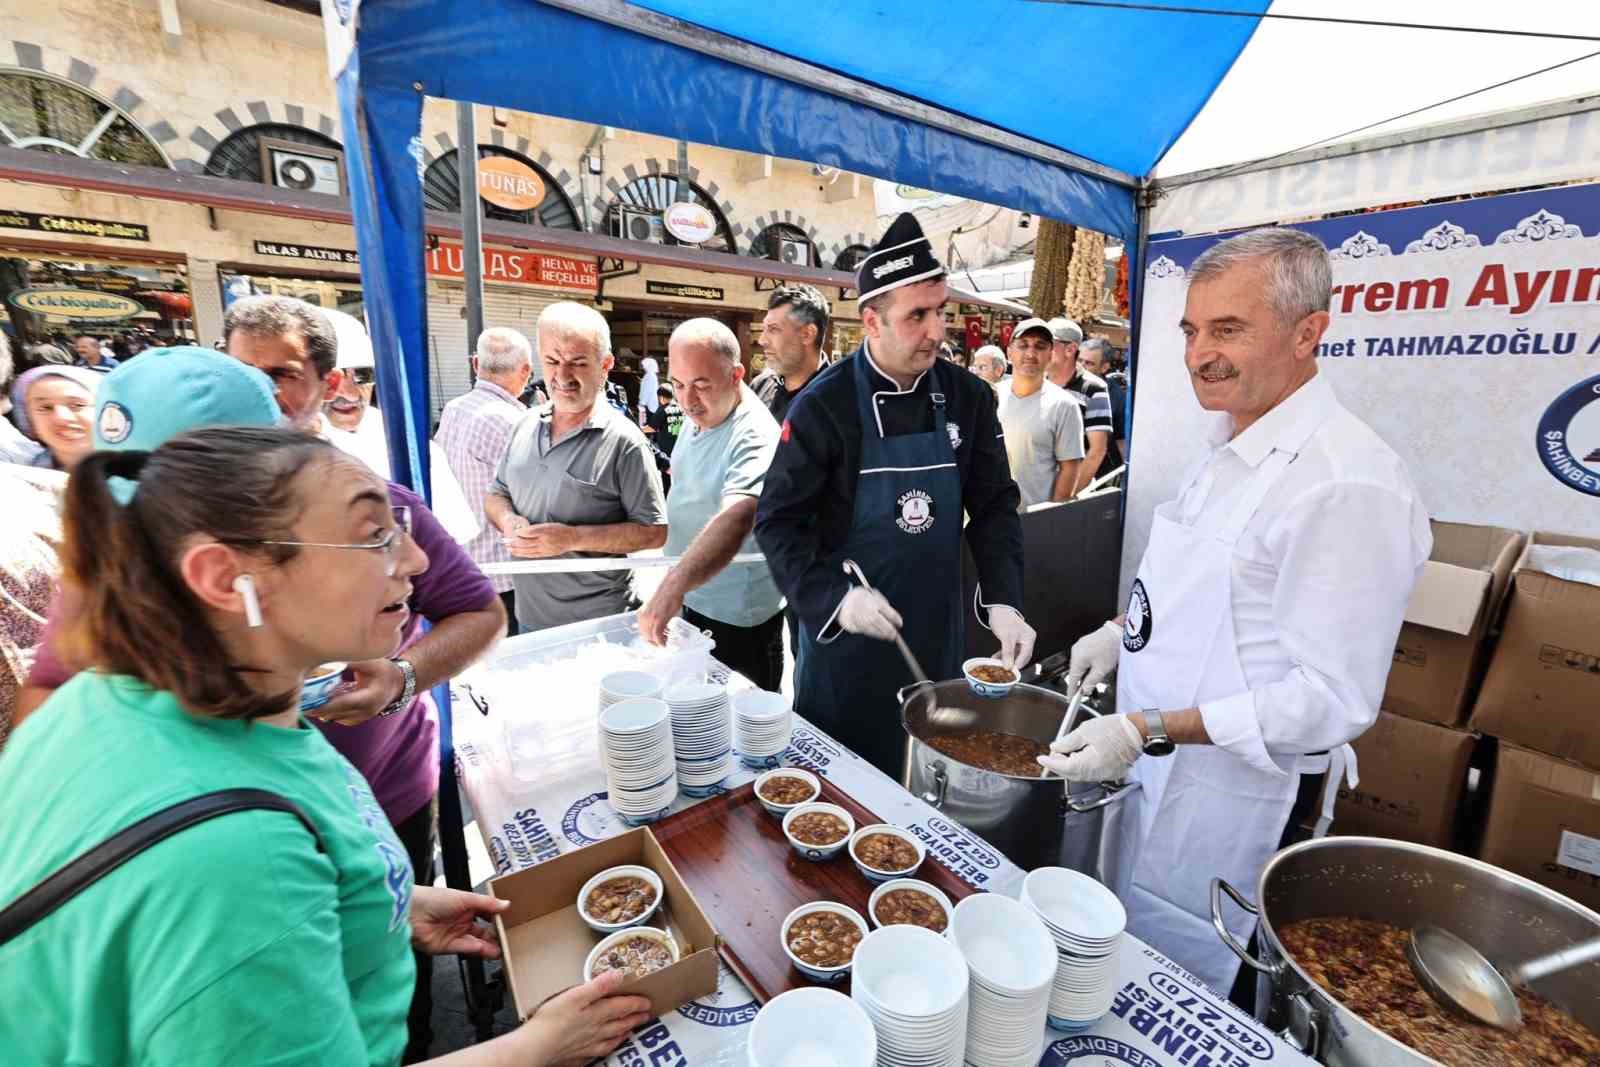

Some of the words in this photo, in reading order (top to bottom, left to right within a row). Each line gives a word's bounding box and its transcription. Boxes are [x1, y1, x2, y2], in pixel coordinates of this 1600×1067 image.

[427, 246, 524, 280] TUAS
[542, 257, 576, 273] HELVA
[583, 263, 598, 274] VE
[1364, 327, 1577, 358] TAHMAZOĞLU
[942, 833, 971, 850] 27
[1157, 978, 1180, 996] 01
[1176, 997, 1223, 1028] 27
[1226, 1024, 1266, 1053] 444
